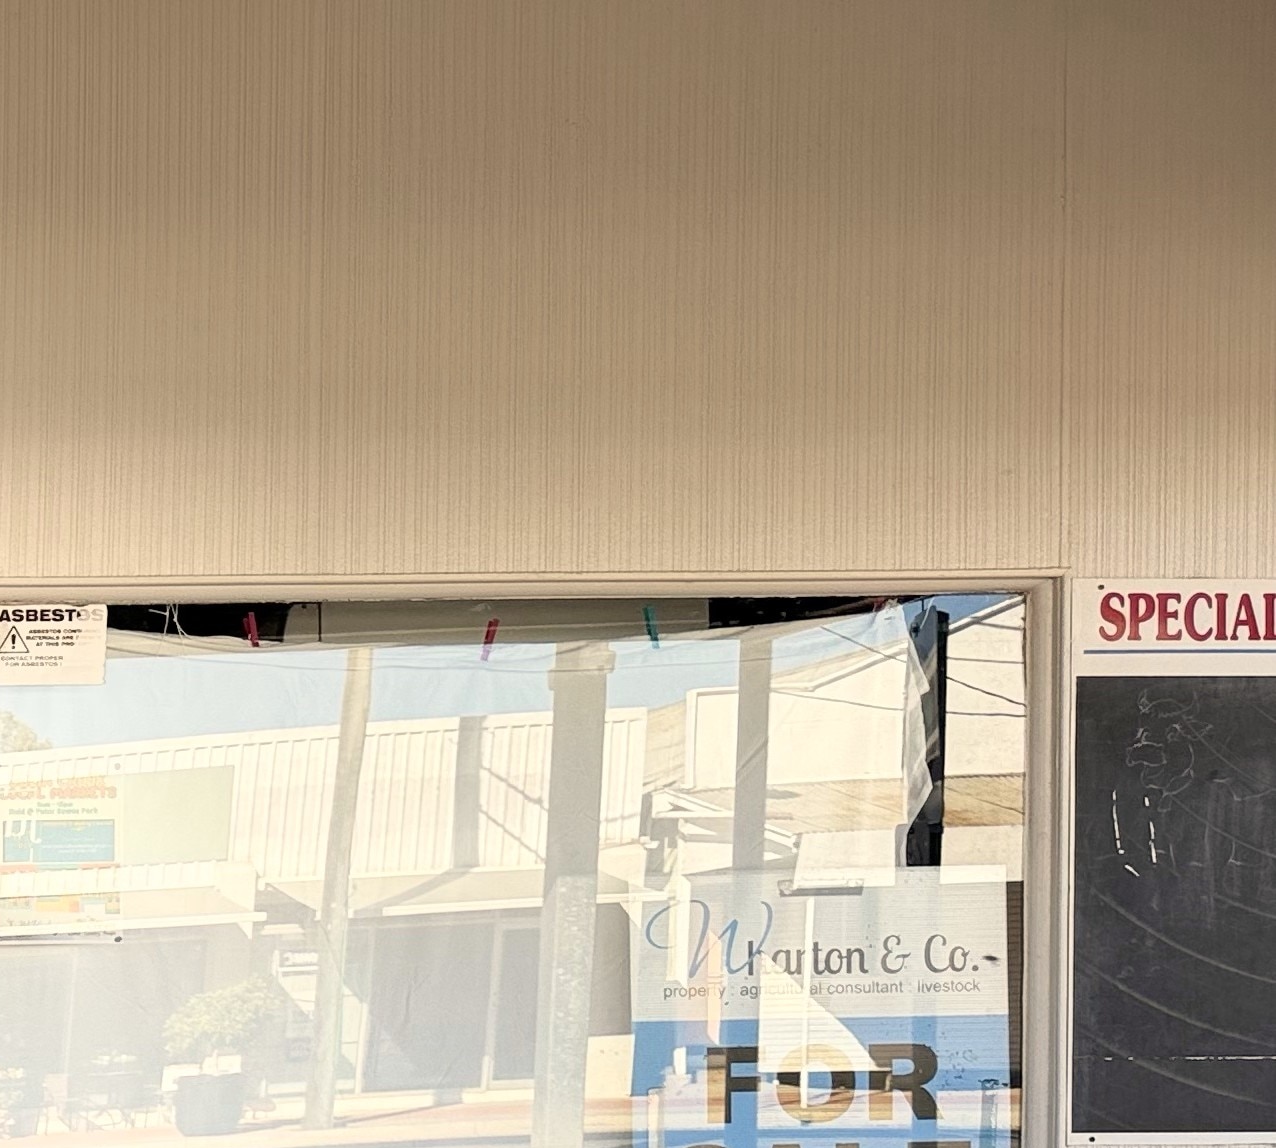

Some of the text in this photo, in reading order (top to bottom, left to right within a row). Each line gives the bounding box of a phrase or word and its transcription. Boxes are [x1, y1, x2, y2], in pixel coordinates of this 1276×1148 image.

[880, 934, 911, 975] &
[924, 933, 980, 975] Co.
[827, 980, 903, 995] consultant
[917, 978, 981, 993] livestock
[706, 1043, 944, 1124] FOR
